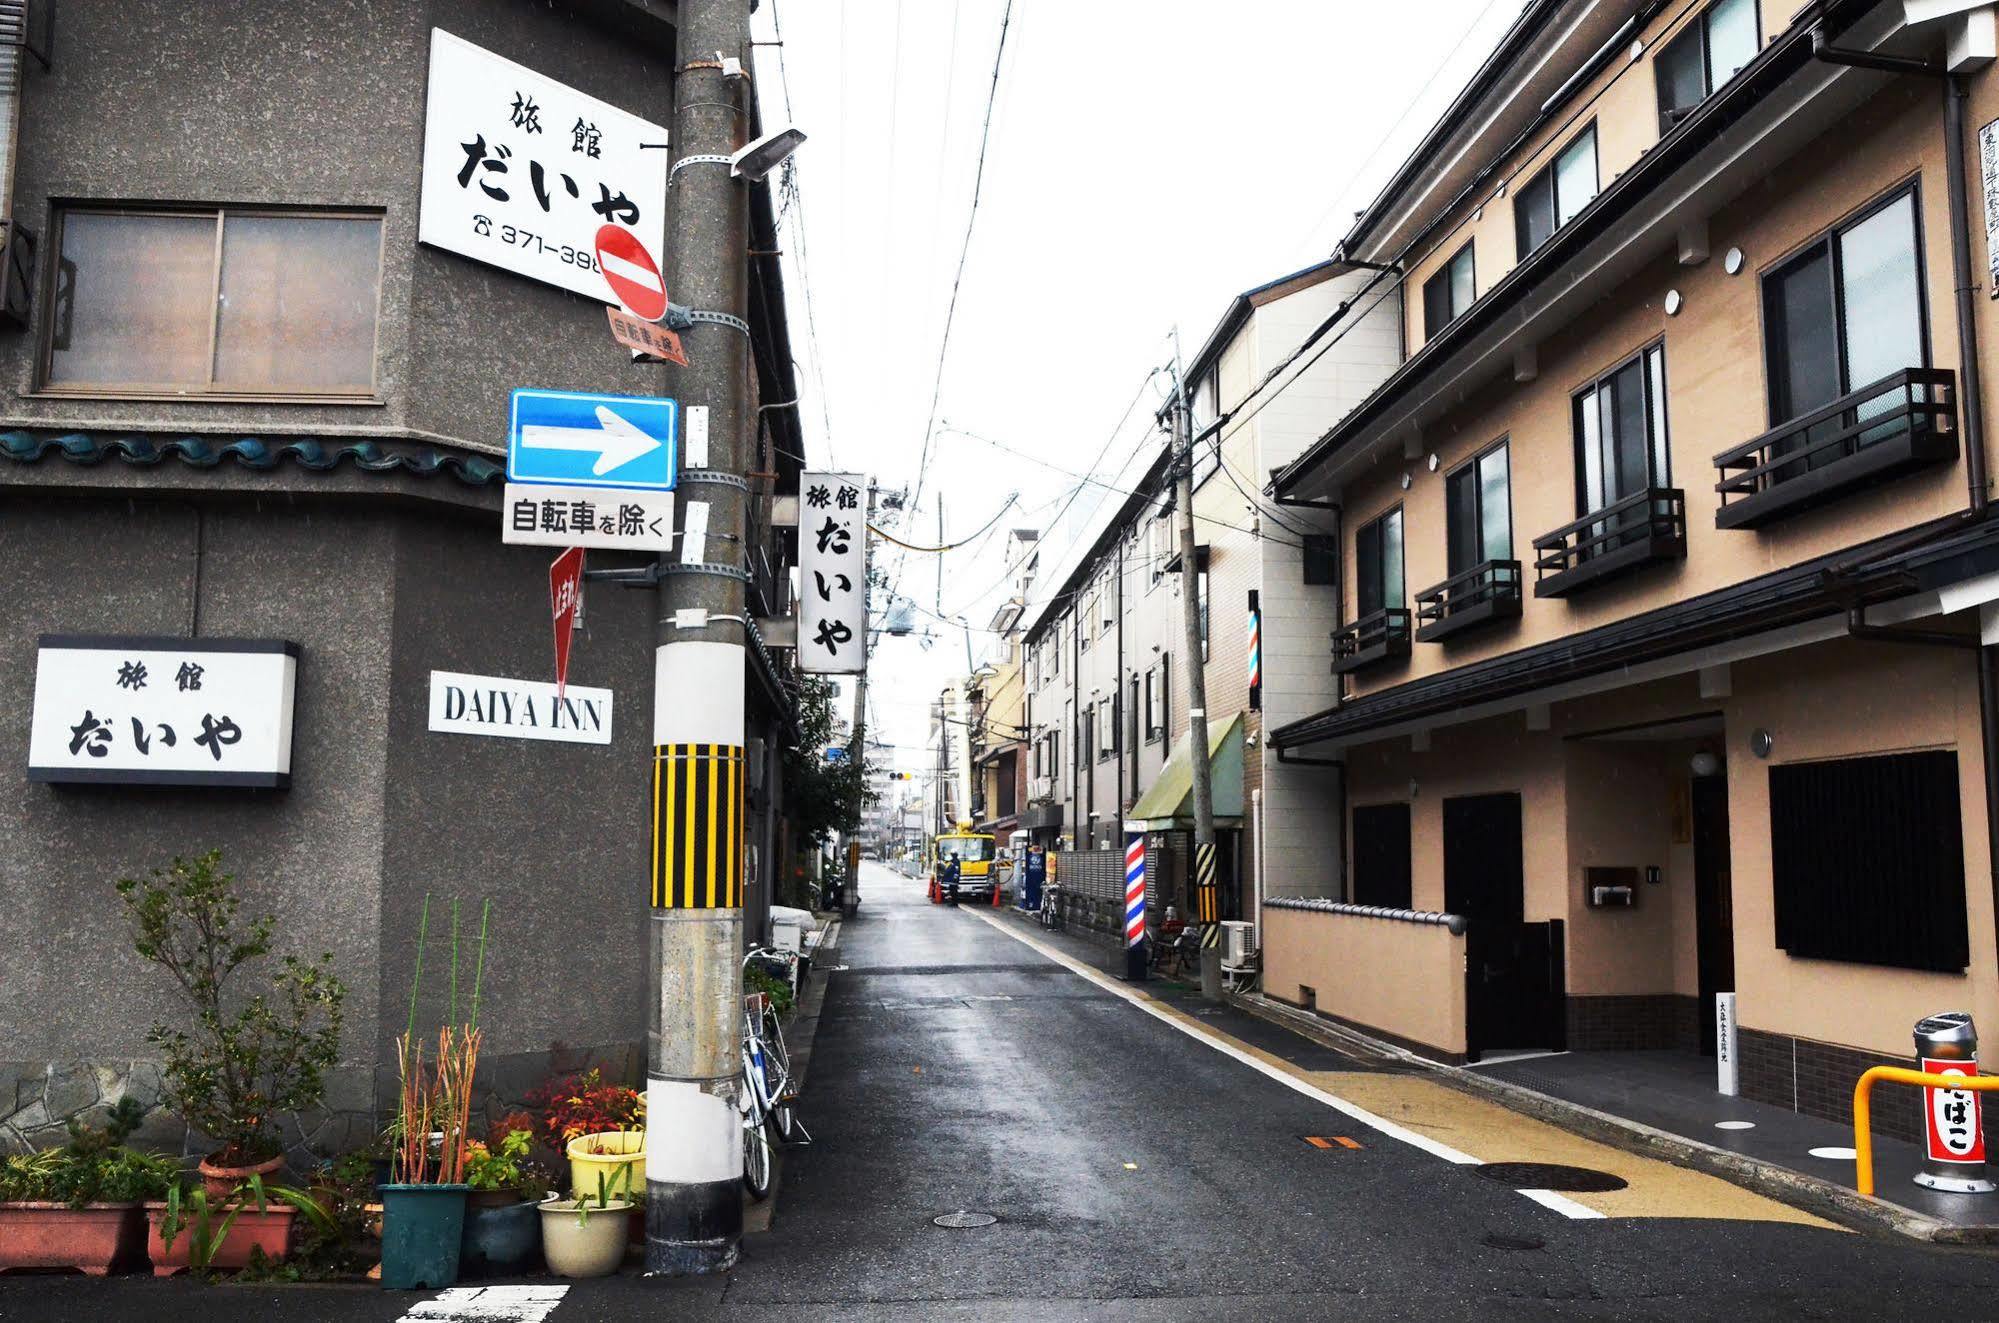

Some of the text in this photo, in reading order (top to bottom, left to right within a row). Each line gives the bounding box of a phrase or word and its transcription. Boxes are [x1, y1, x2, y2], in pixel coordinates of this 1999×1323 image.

[509, 91, 602, 160] 旅館
[457, 133, 640, 226] だいや
[513, 499, 663, 537] 自転車を除く
[806, 484, 859, 510] 旅館
[813, 516, 852, 656] だいや
[116, 660, 205, 692] 旅館
[443, 686, 603, 733] DAIYA INN
[69, 710, 242, 762] だいや
